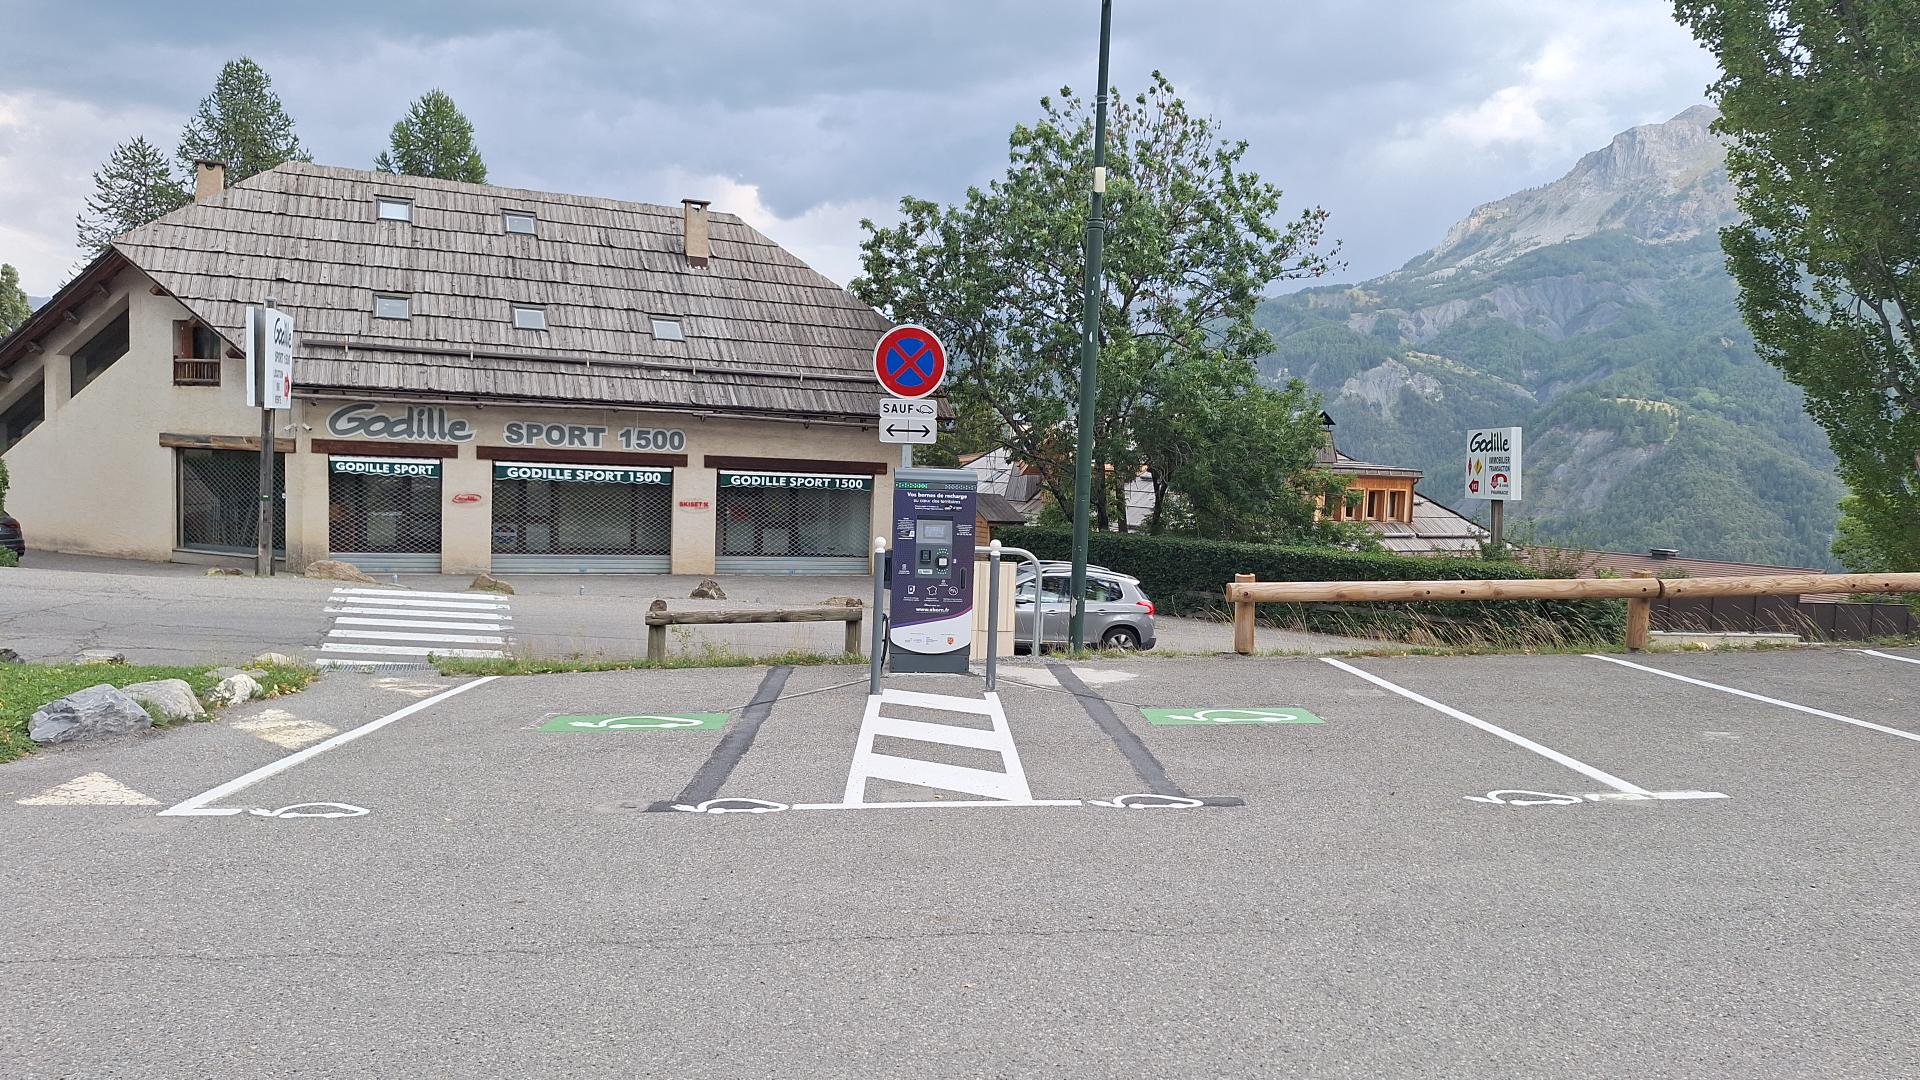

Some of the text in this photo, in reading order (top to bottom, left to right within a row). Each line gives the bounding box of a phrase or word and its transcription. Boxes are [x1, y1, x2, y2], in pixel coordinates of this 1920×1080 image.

[274, 317, 292, 349] Godille
[883, 403, 914, 414] SAUF
[328, 402, 475, 442] Godille
[504, 422, 686, 451] SPORT 1500
[1470, 431, 1510, 453] Godille
[336, 461, 434, 475] GODILLE SPORT
[1489, 456, 1511, 465] IMMOBILIER
[507, 467, 662, 483] GODILLE SPORT 1500
[731, 475, 863, 489] GODILLE SPORT 1500
[945, 493, 967, 501] recharge
